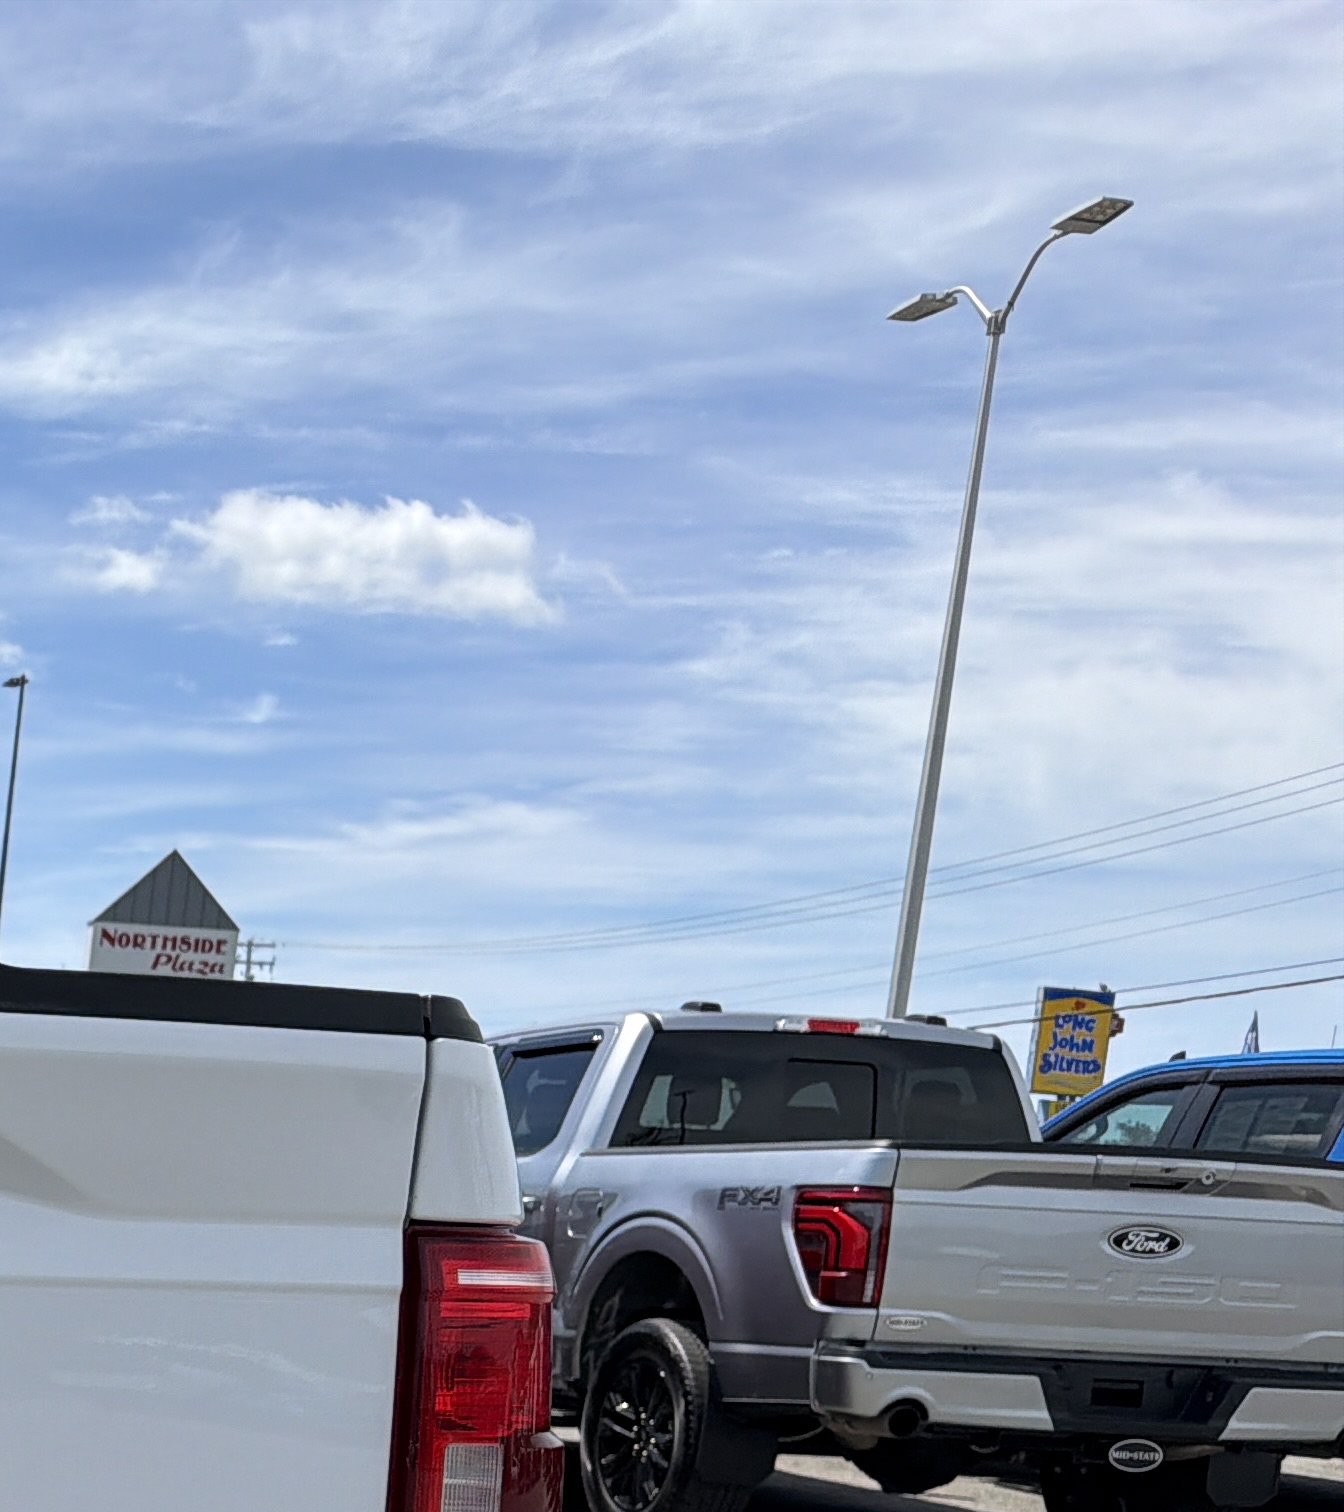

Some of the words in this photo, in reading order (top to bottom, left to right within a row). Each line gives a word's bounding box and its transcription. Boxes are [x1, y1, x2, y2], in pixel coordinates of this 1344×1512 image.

[99, 927, 228, 956] NORTHSIDE
[151, 952, 225, 975] Plaza
[717, 1185, 782, 1211] FX4
[1121, 1230, 1171, 1252] Ford
[976, 1264, 1297, 1309] F-150
